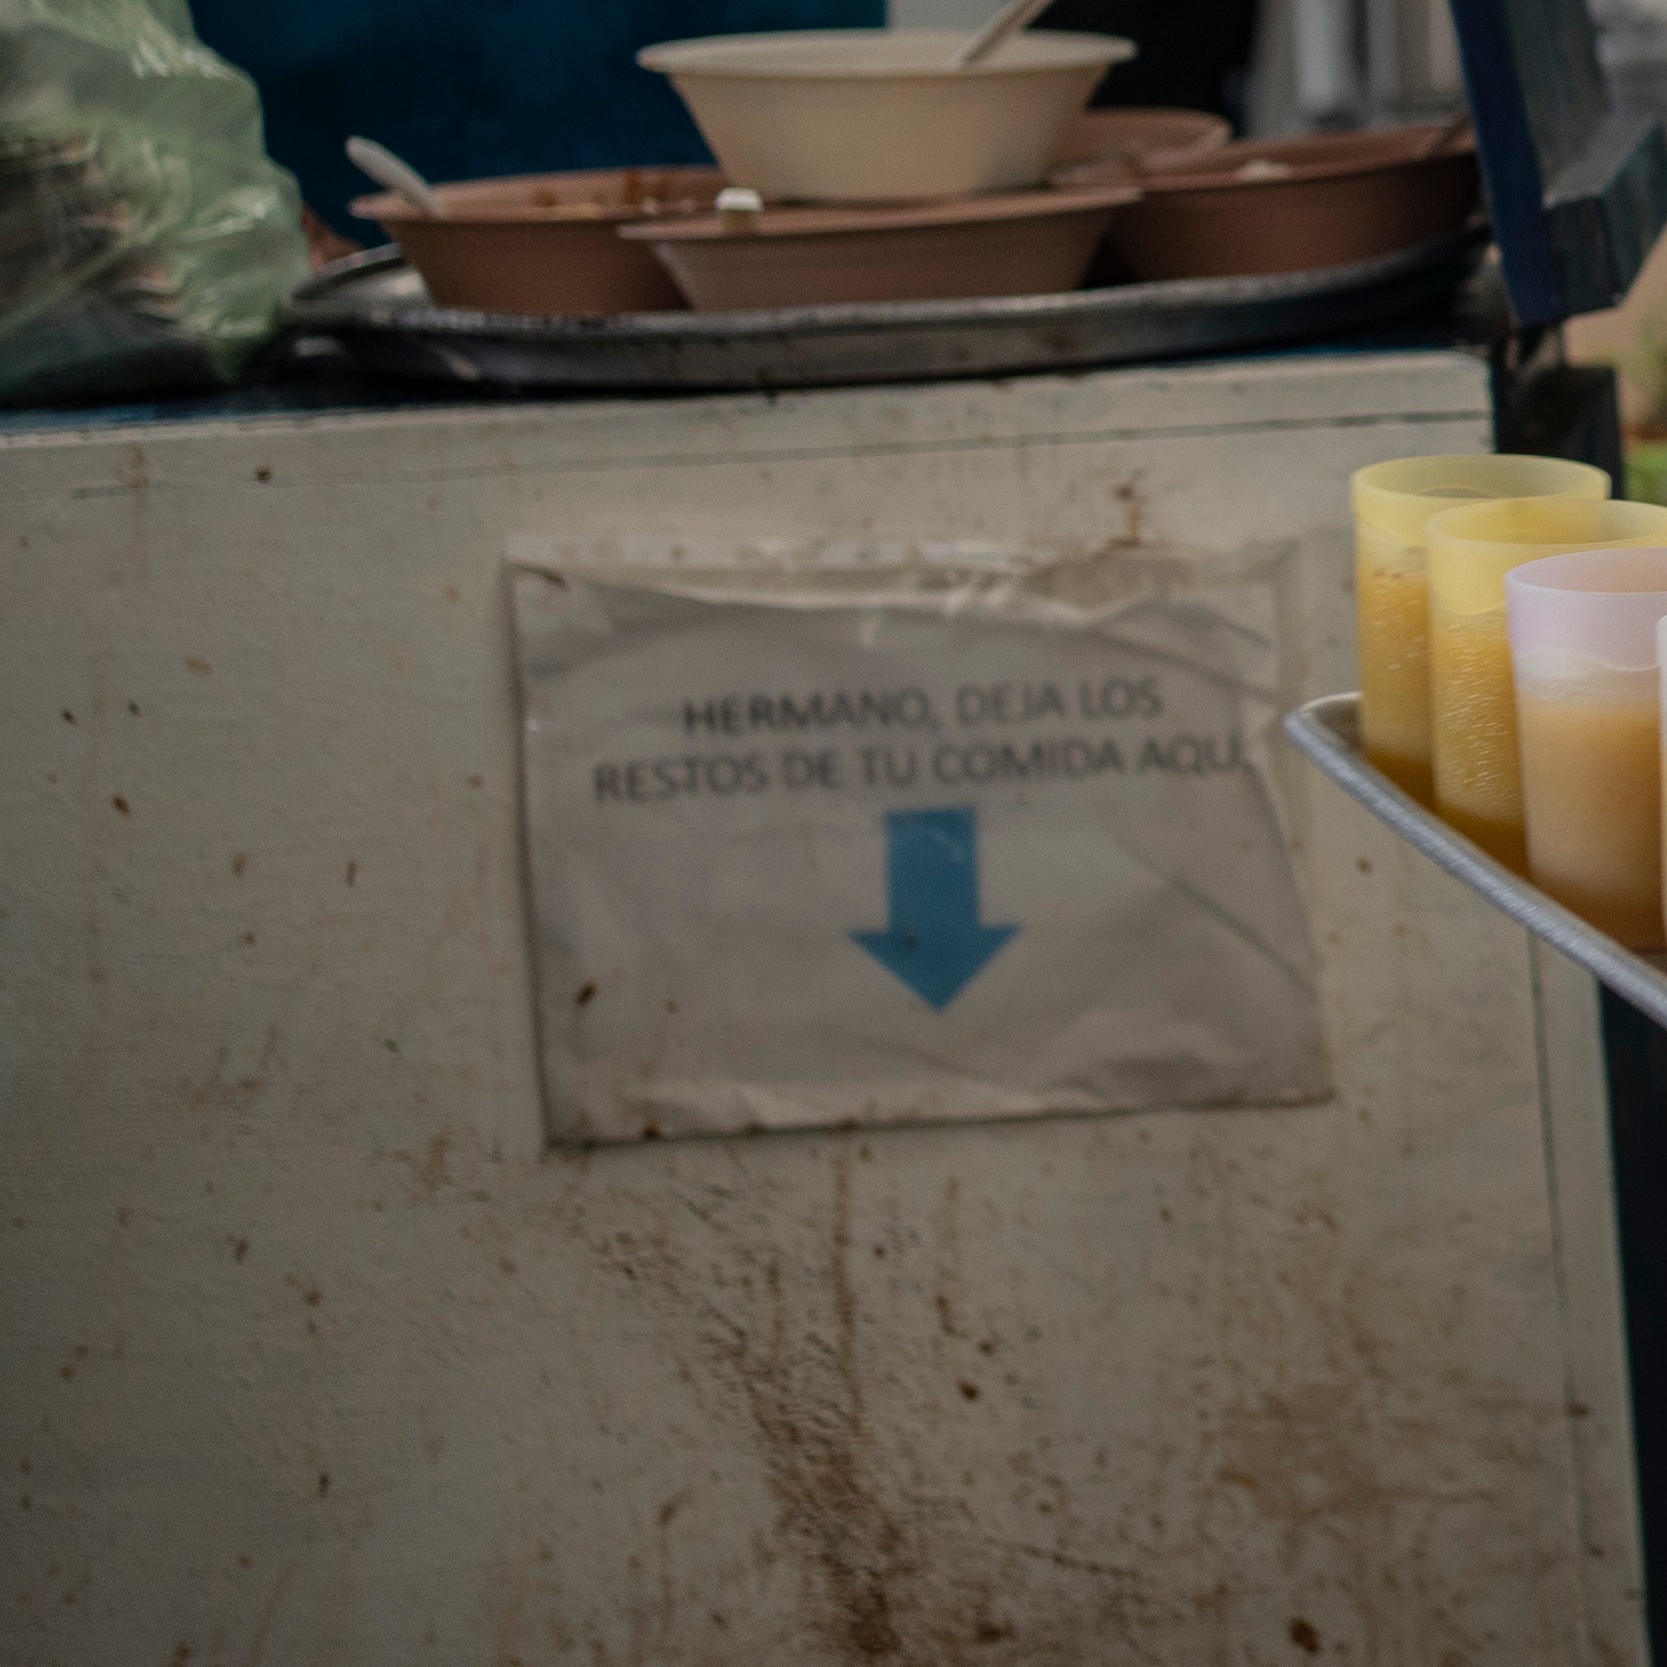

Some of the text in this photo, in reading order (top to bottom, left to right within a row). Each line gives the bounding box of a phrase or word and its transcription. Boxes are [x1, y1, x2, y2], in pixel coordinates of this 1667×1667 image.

[682, 674, 1166, 735] HERMANO, DEJA LOS
[593, 752, 770, 803] RESTOS
[784, 748, 845, 792] DE
[860, 745, 920, 787] TU
[933, 735, 1123, 784] COMIDA
